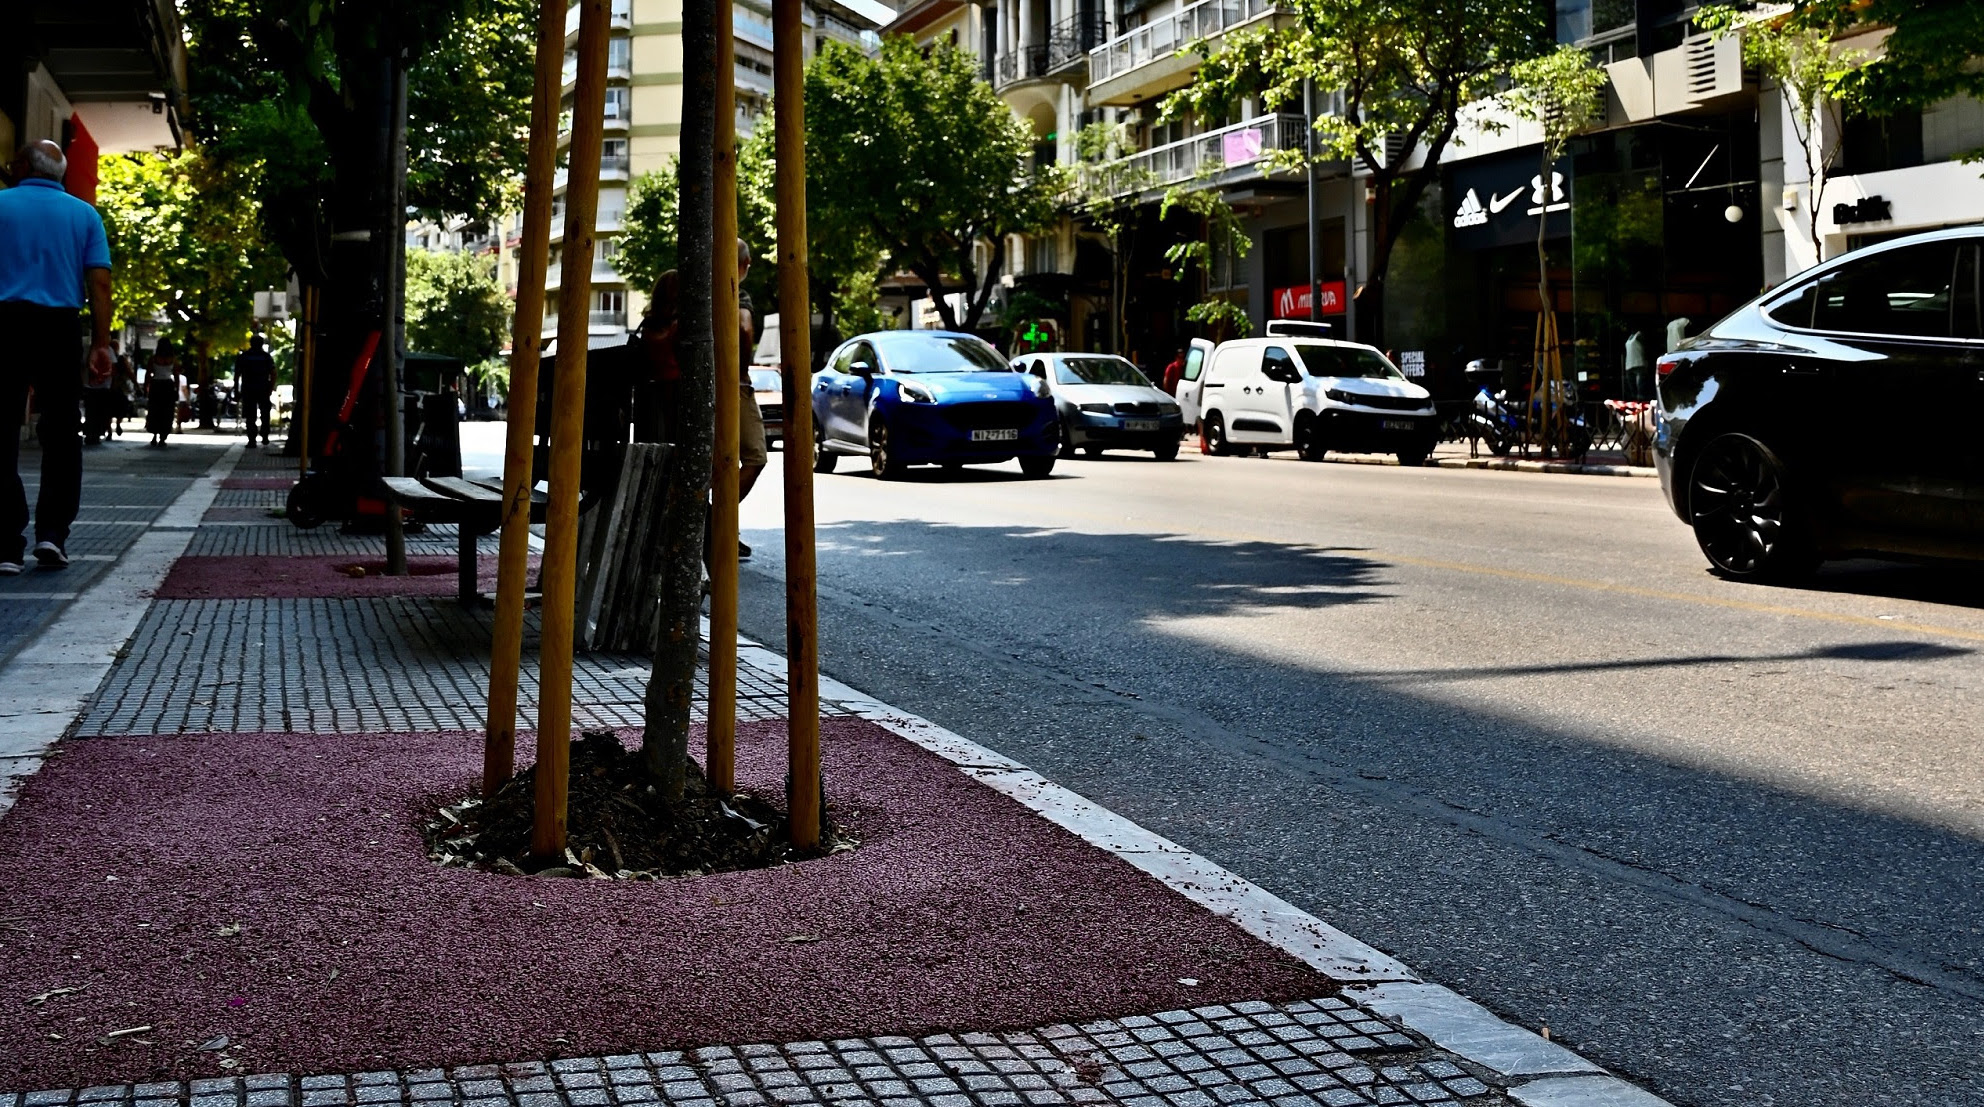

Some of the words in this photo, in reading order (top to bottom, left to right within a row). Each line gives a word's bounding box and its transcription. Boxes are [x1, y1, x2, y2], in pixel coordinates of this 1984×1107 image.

[1454, 208, 1488, 228] adidas
[1401, 351, 1425, 363] SPECIAL
[1401, 363, 1425, 377] OFFERS
